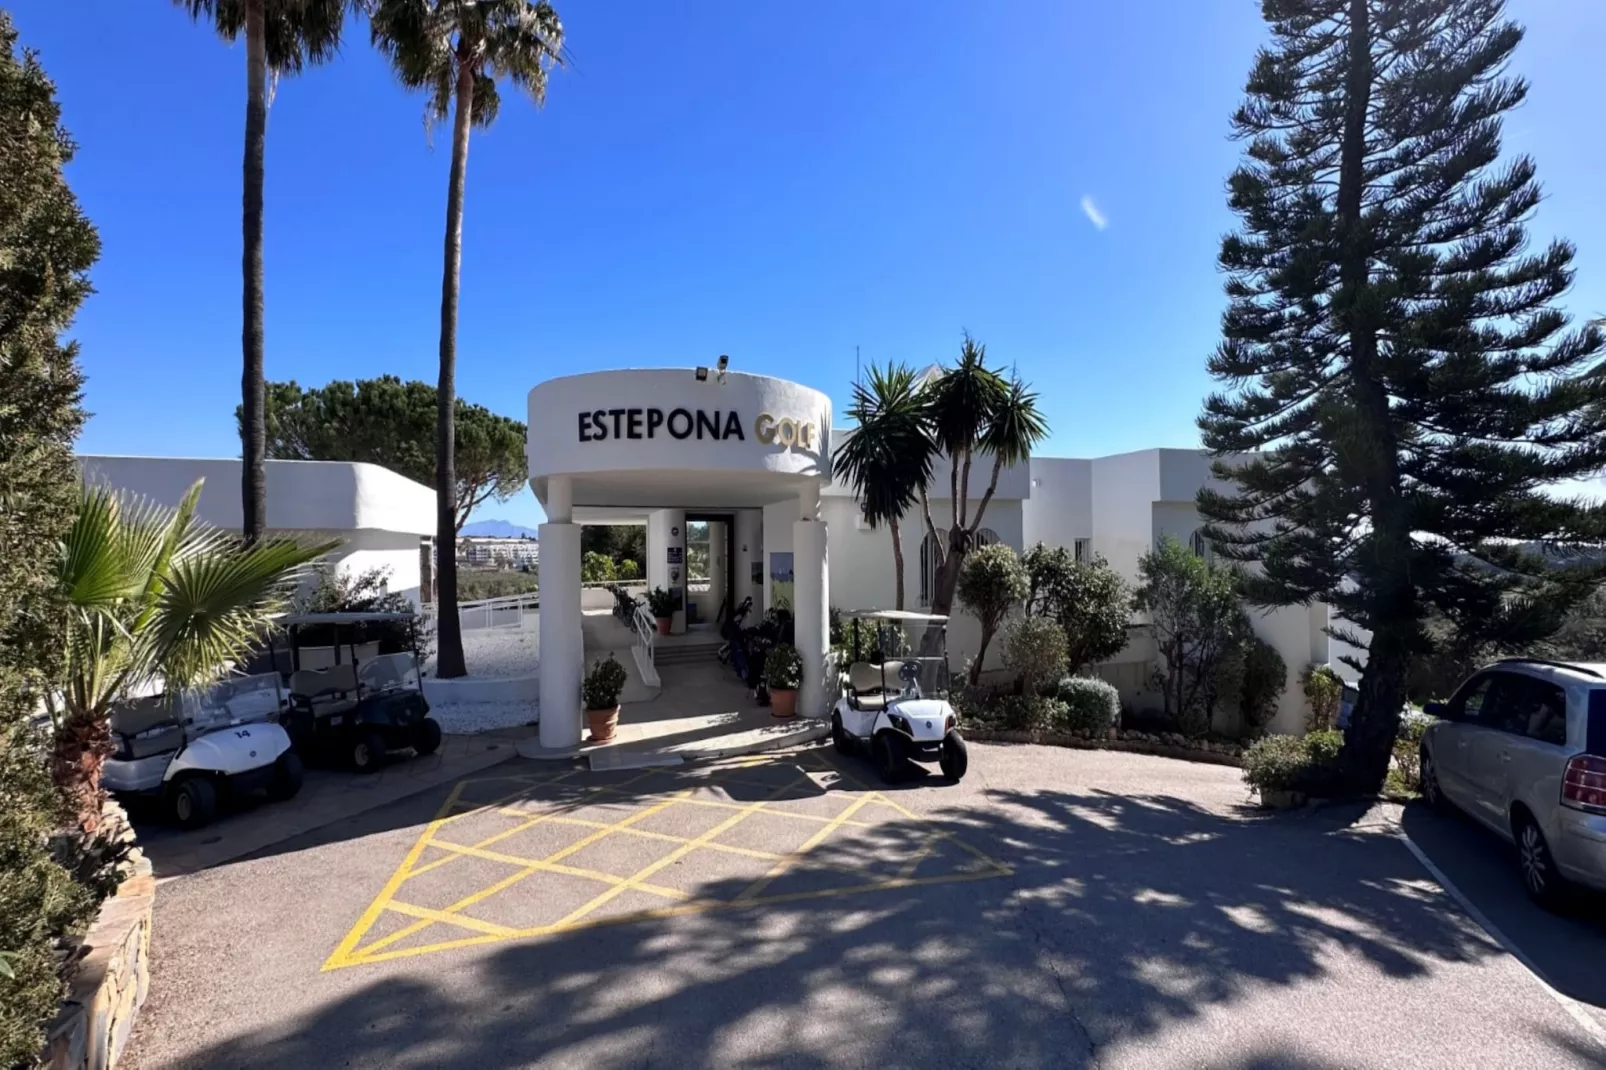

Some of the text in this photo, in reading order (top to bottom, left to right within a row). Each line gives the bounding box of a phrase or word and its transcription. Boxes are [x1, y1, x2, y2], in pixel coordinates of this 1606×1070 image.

[578, 408, 815, 448] ESTEPONA GOLF
[234, 729, 251, 739] 14
